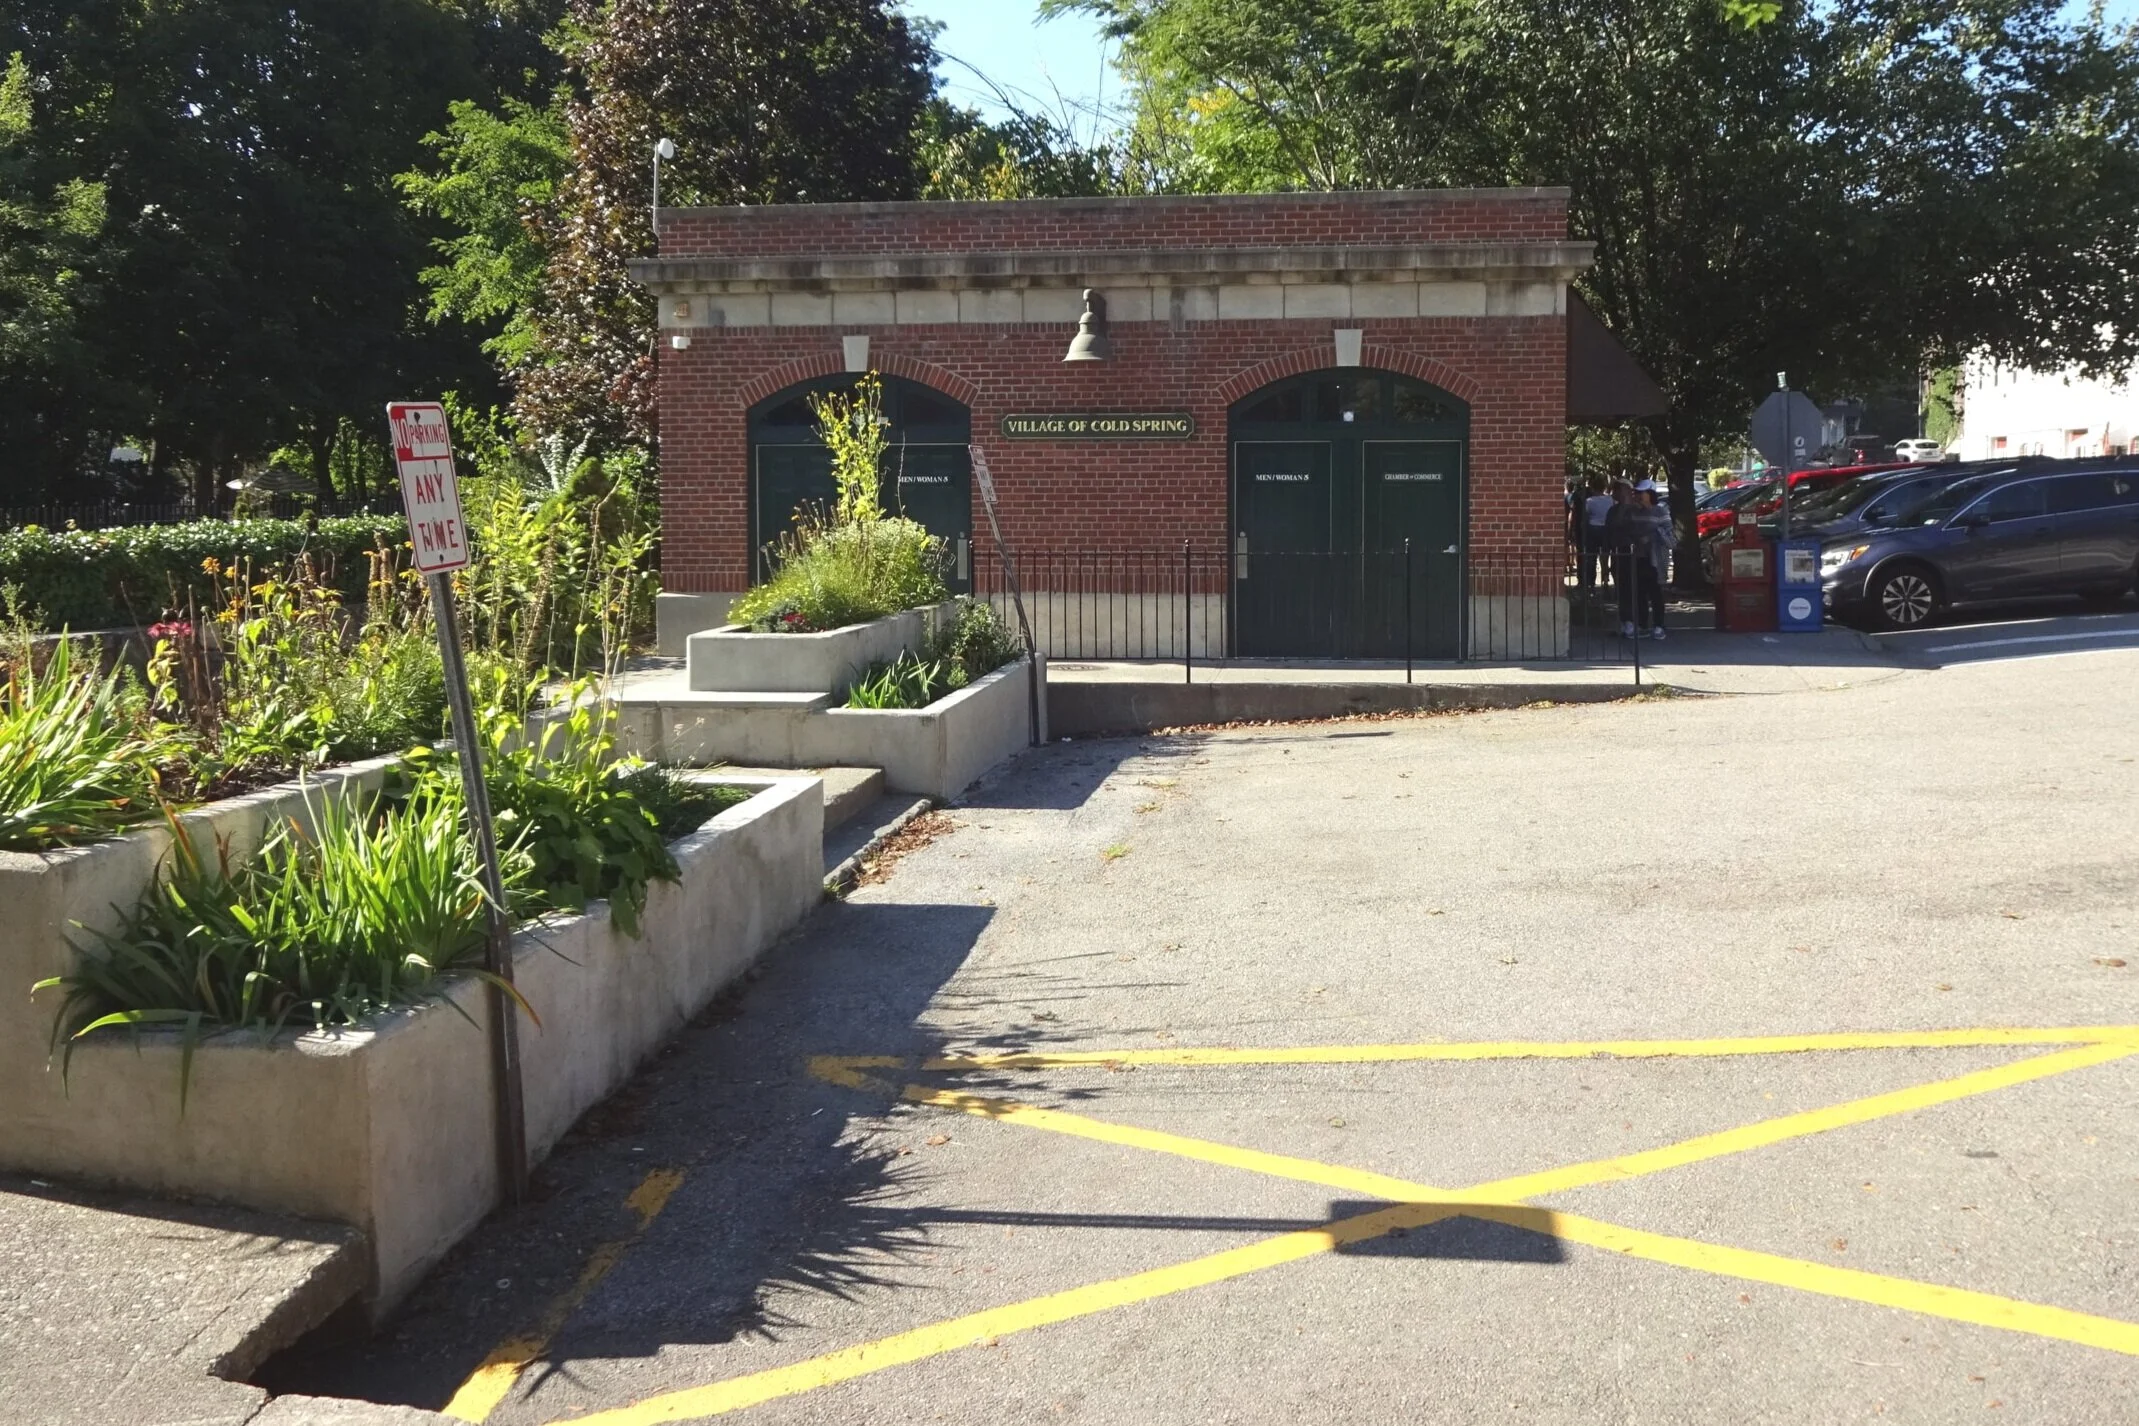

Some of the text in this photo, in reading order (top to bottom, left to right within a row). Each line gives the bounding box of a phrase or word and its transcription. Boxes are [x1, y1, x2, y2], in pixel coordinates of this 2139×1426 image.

[391, 418, 445, 449] NO PARKING
[1007, 419, 1188, 432] VILLAGE OF COLD SPRING
[415, 473, 444, 504] ANY
[418, 519, 459, 552] TIME
